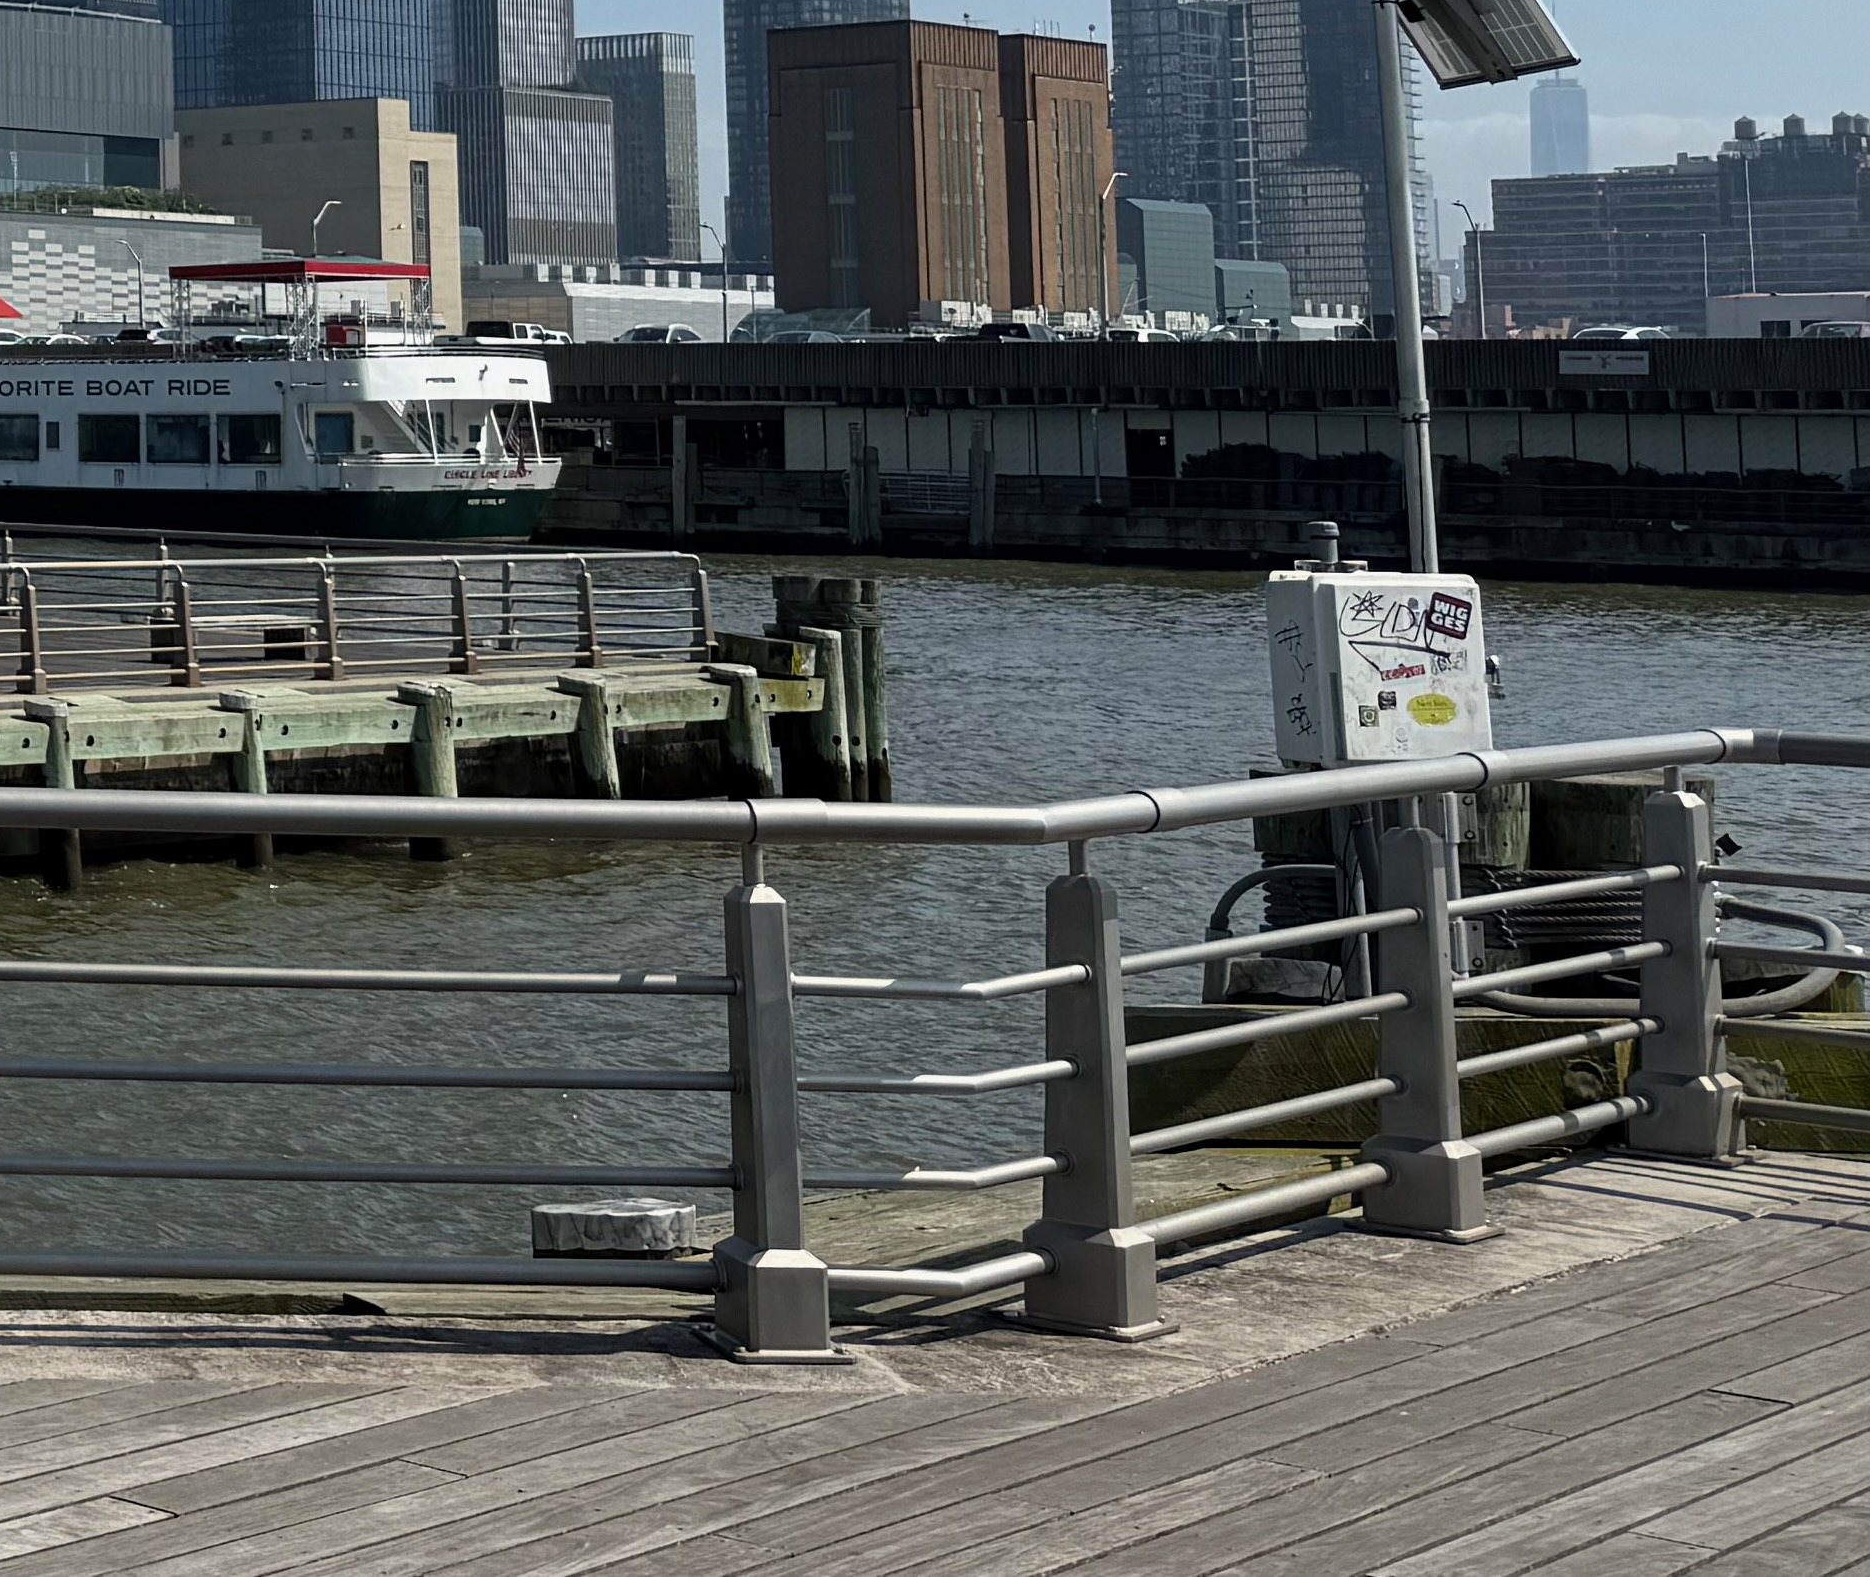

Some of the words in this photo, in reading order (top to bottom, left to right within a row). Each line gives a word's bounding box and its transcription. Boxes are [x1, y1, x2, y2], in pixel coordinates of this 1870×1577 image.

[86, 379, 155, 397] BOAT
[167, 379, 231, 396] RIDE
[1434, 599, 1468, 621] WIG
[1430, 612, 1466, 633] GES
